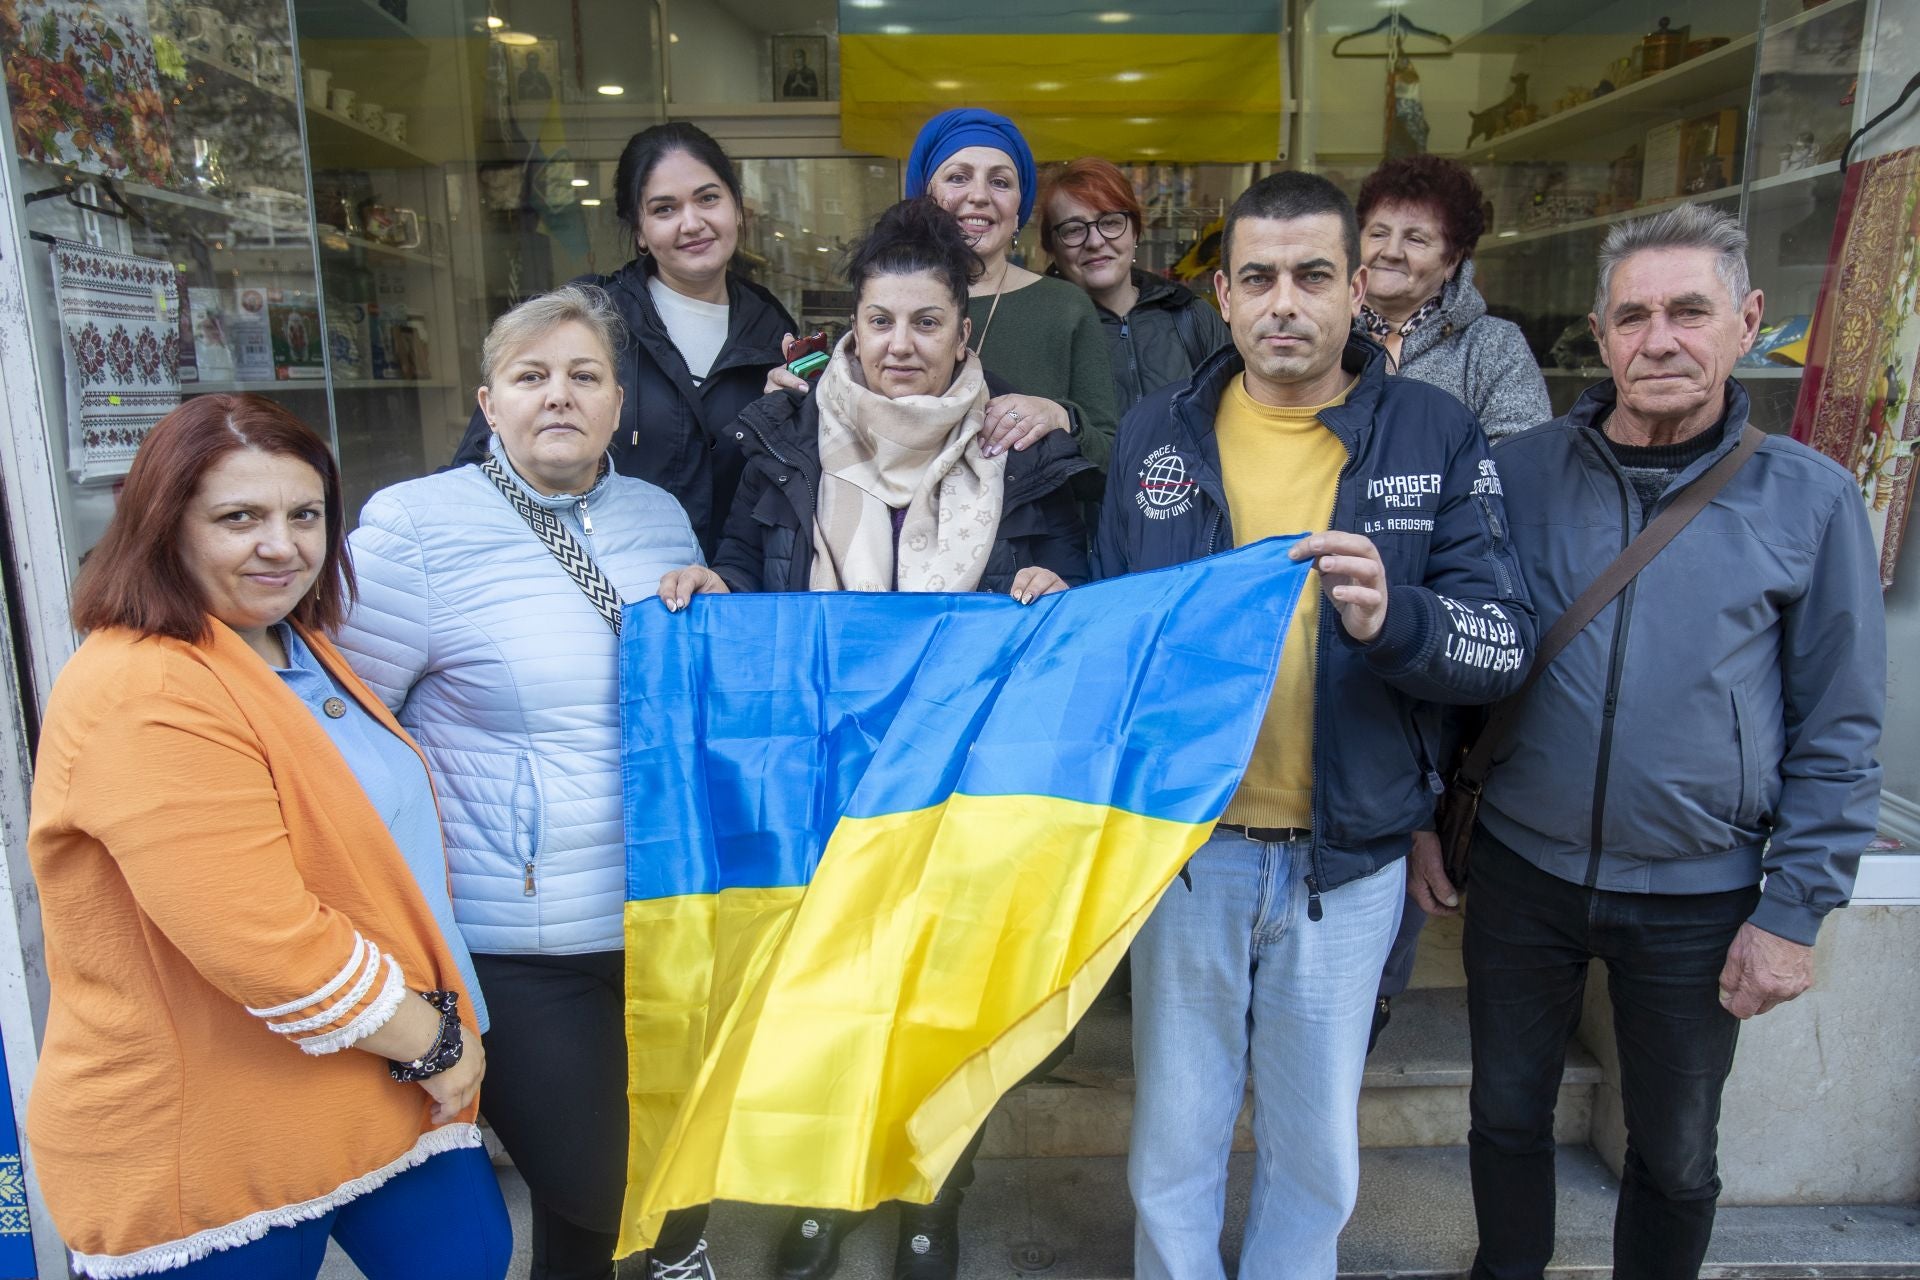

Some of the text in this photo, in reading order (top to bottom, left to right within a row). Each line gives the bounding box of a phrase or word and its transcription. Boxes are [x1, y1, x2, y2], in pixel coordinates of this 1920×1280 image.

[1143, 444, 1171, 467] SPACE
[1367, 474, 1442, 500] VOYAGER
[1171, 497, 1193, 517] UNIT
[1384, 493, 1423, 509] PRJCT
[1364, 521, 1384, 533] U.S.
[1444, 633, 1525, 673] ASTRONAUT
